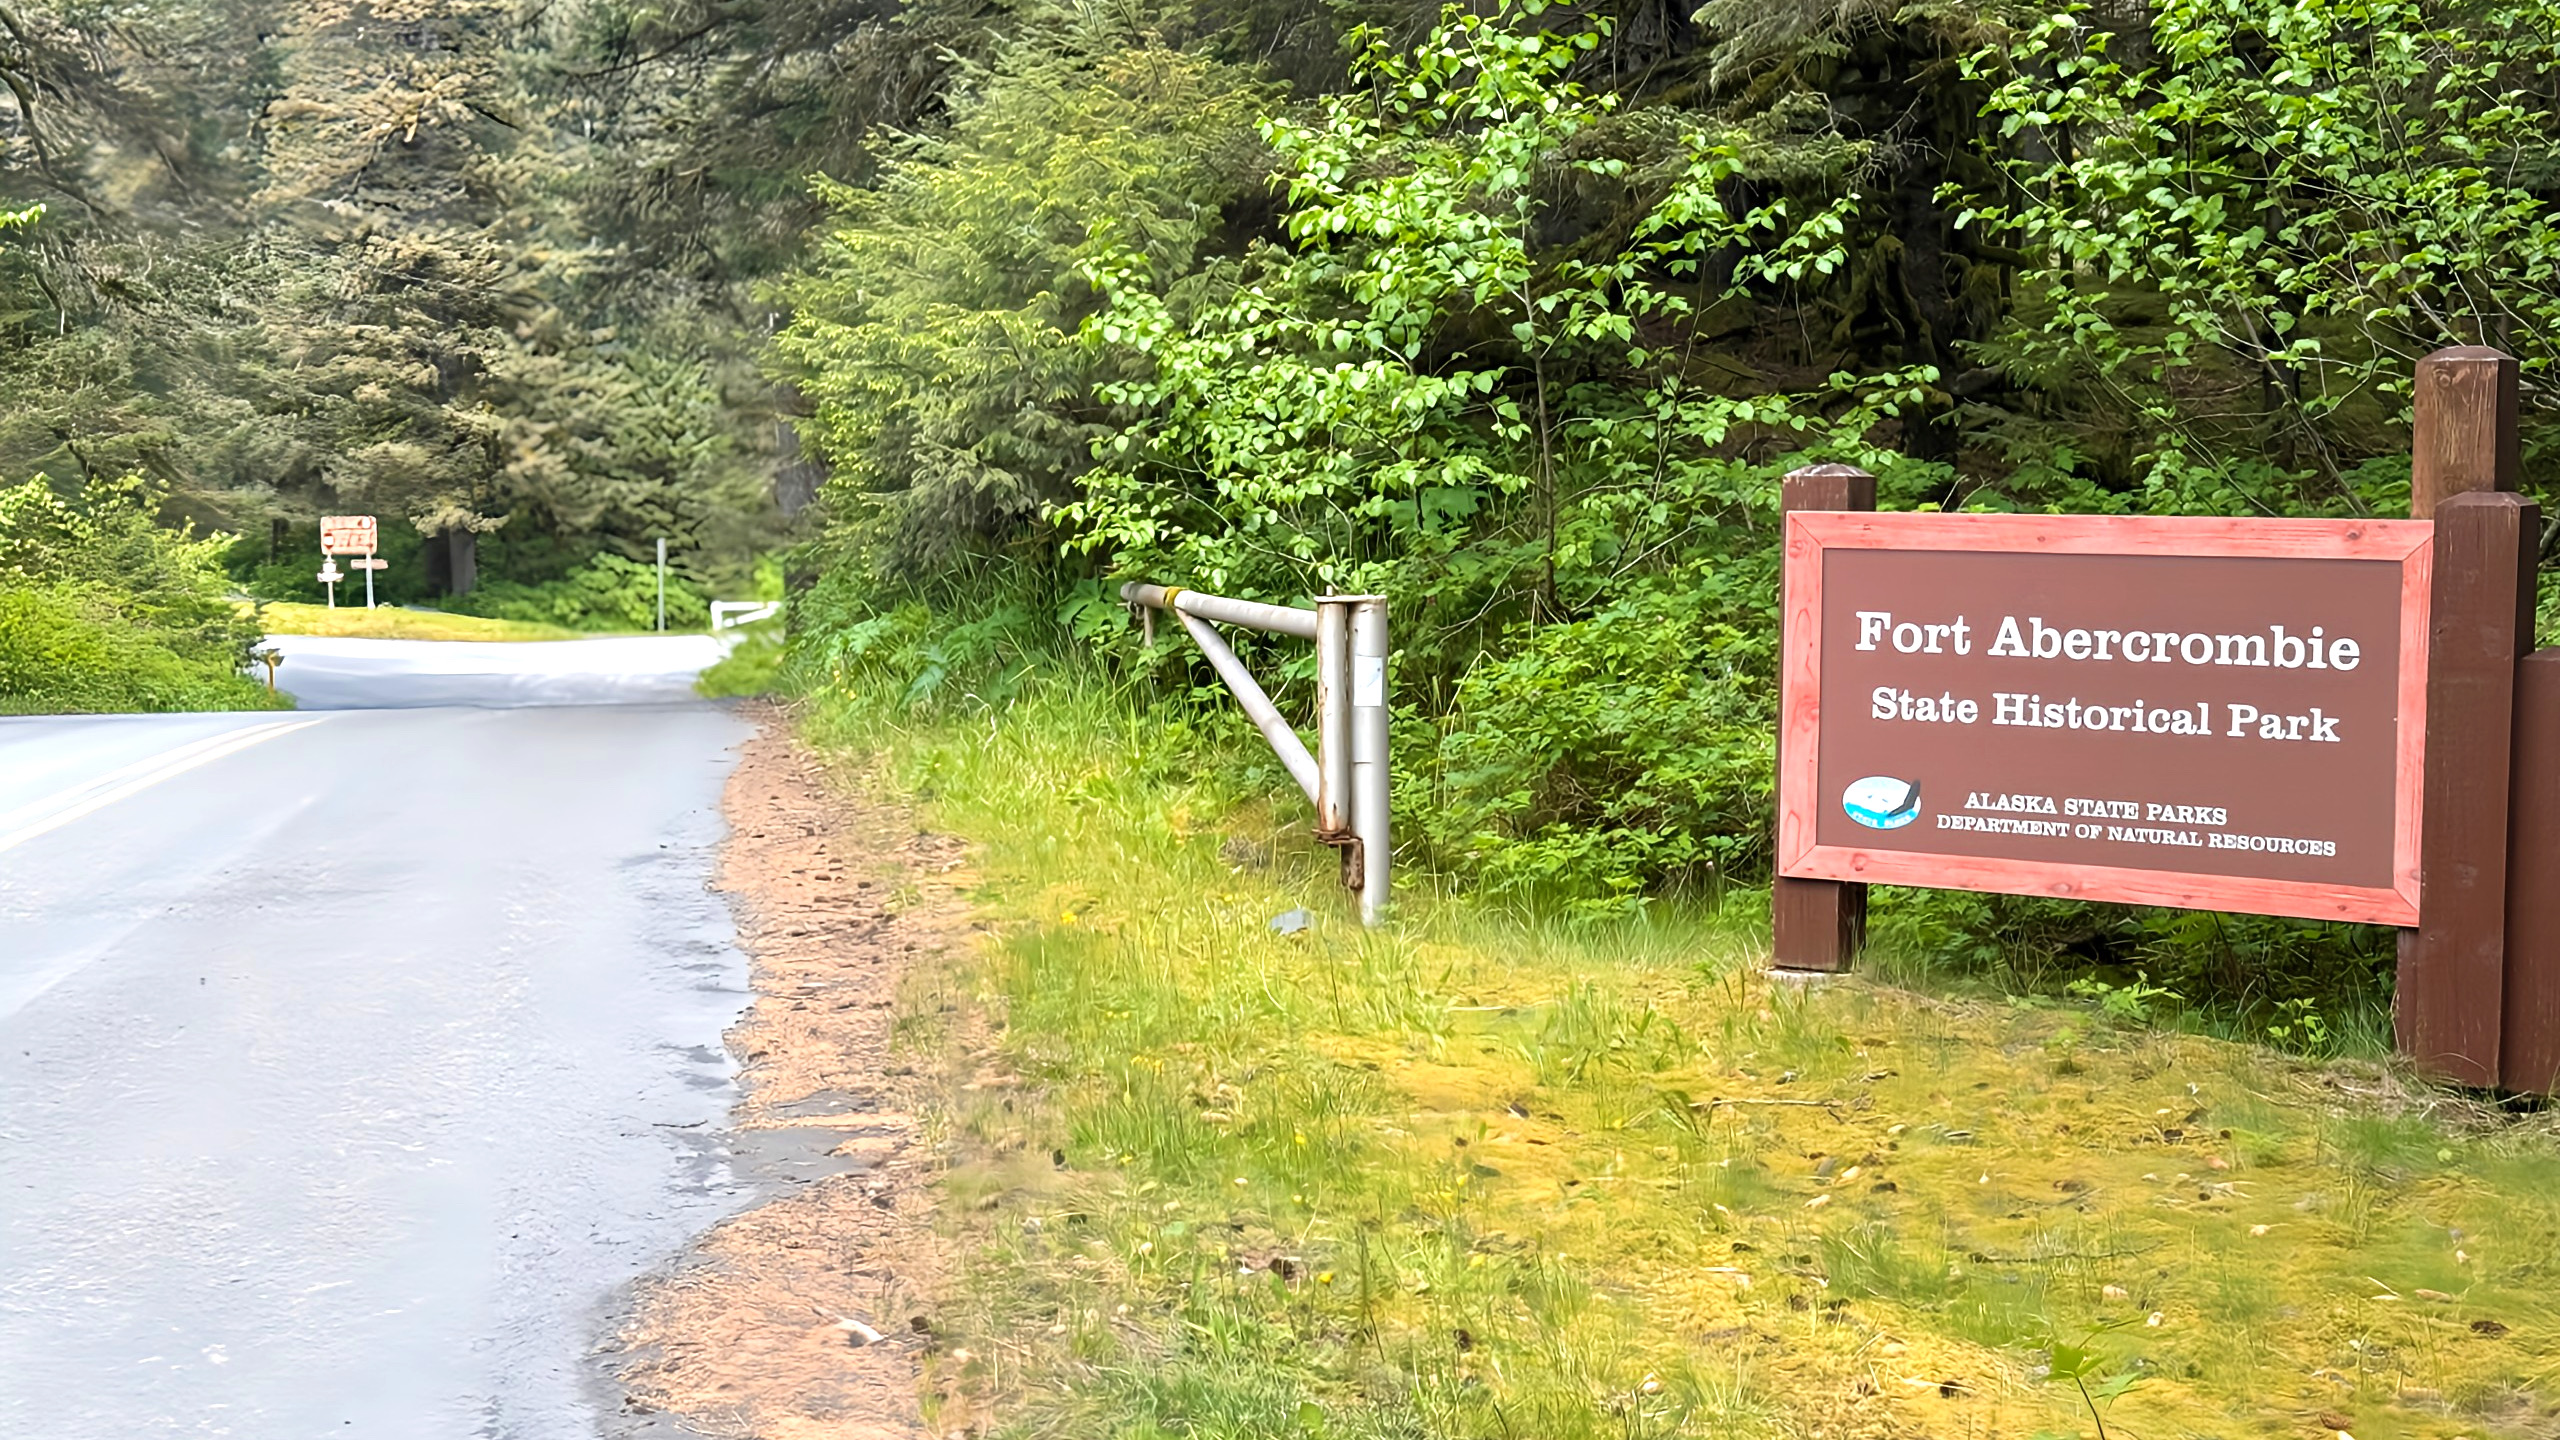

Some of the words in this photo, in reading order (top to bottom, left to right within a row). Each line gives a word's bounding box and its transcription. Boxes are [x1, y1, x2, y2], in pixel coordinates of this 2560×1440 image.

[1854, 611, 1972, 655] Fort
[1987, 615, 2360, 671] Abercrombie
[1871, 686, 1979, 724] State
[1992, 692, 2213, 736] Historical
[2226, 703, 2341, 743] Park
[1963, 791, 2058, 815] ALASKA
[2064, 797, 2140, 820] STATE
[2145, 802, 2228, 826] PARKS
[1936, 814, 2071, 838] DEPARTMENT
[2074, 823, 2104, 840] OF
[2106, 825, 2203, 847] NATURAL
[2207, 832, 2336, 857] RESOURCES
